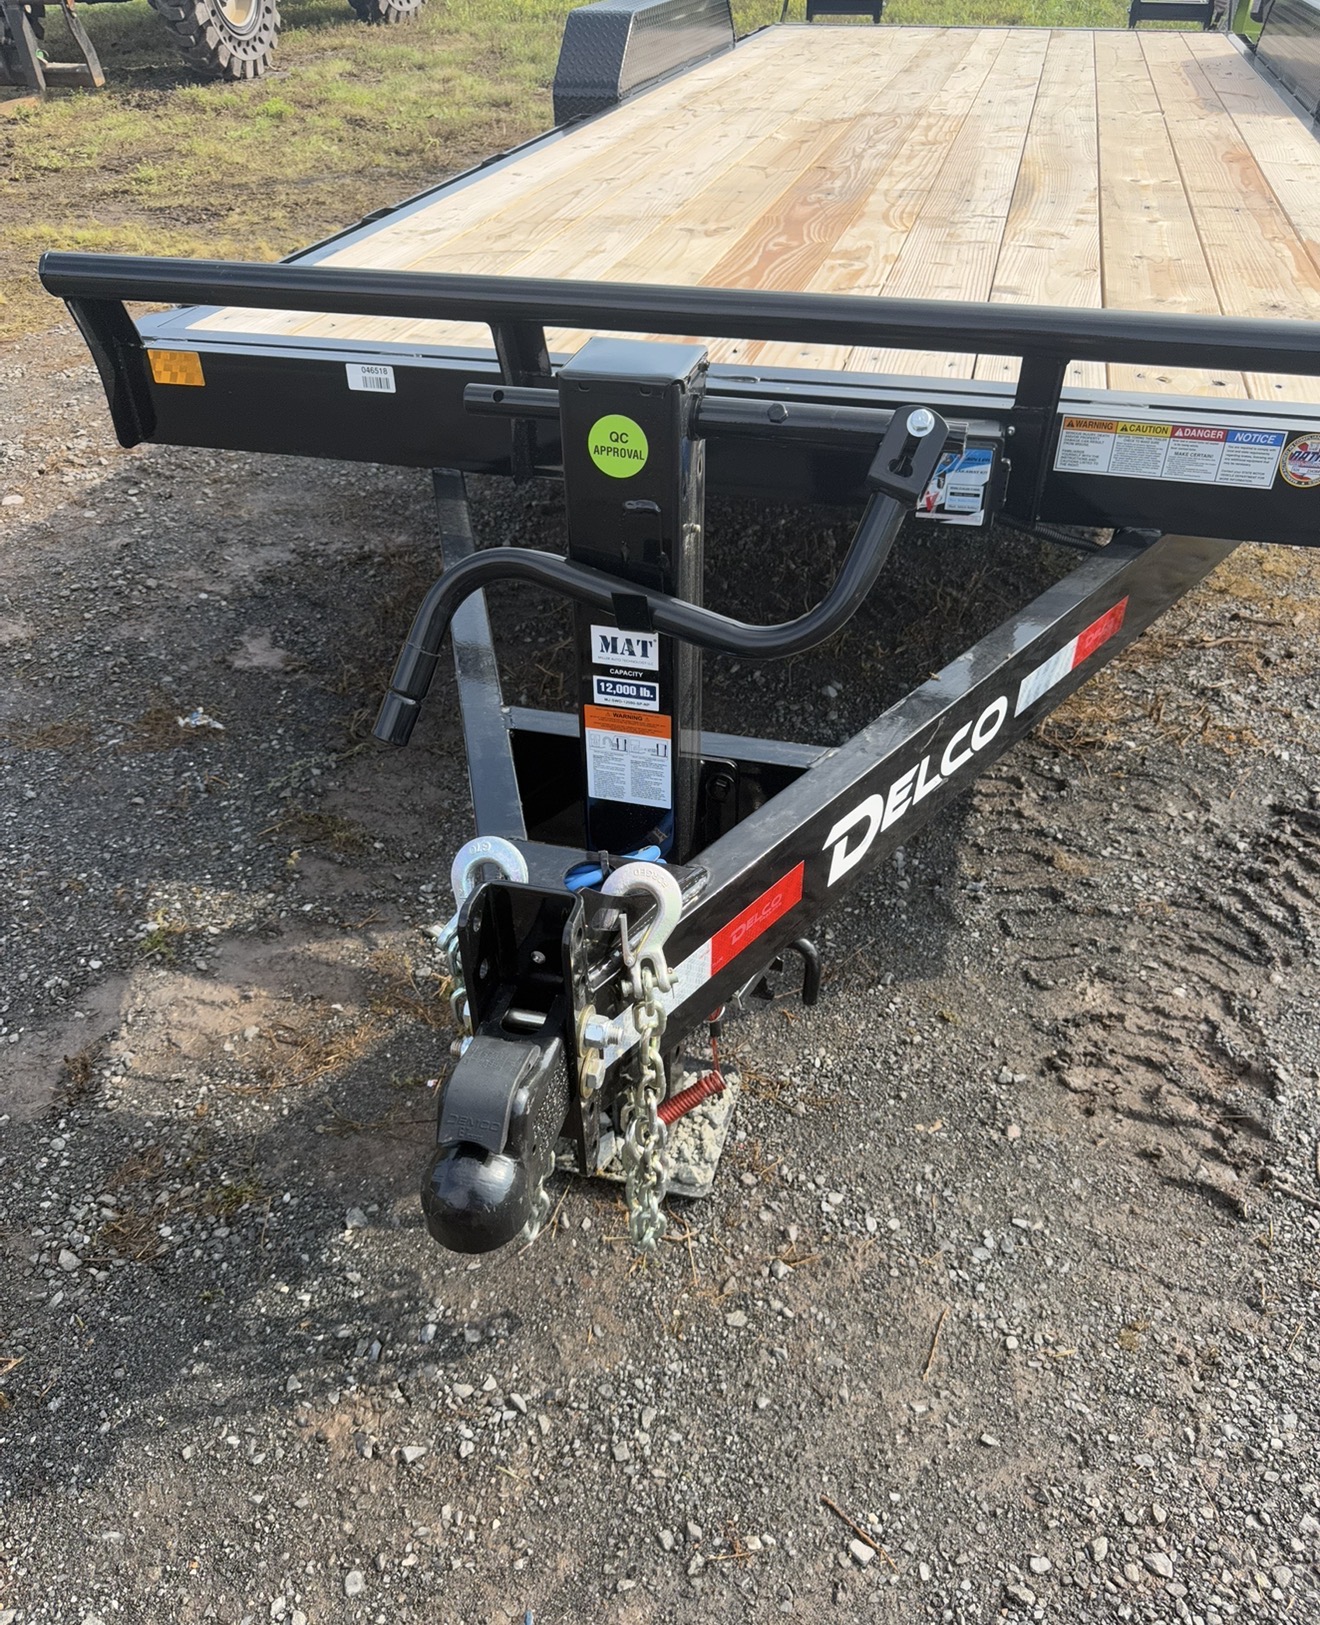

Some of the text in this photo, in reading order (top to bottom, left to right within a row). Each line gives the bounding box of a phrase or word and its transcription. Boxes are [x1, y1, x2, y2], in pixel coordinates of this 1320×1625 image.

[361, 366, 388, 375] 046518
[1075, 420, 1114, 431] WARNING
[1129, 424, 1169, 434] CAUTION
[609, 431, 629, 444] QC
[1183, 428, 1224, 439] DANGER
[1234, 433, 1277, 444] NOTICE
[593, 445, 645, 461] APPROVAL
[599, 634, 653, 659] MAT
[610, 668, 644, 678] CAPACITY
[600, 682, 654, 698] 12,000 lb.
[612, 712, 642, 721] WARNING
[822, 695, 1008, 888] DELCO
[730, 893, 783, 946] DELCO
